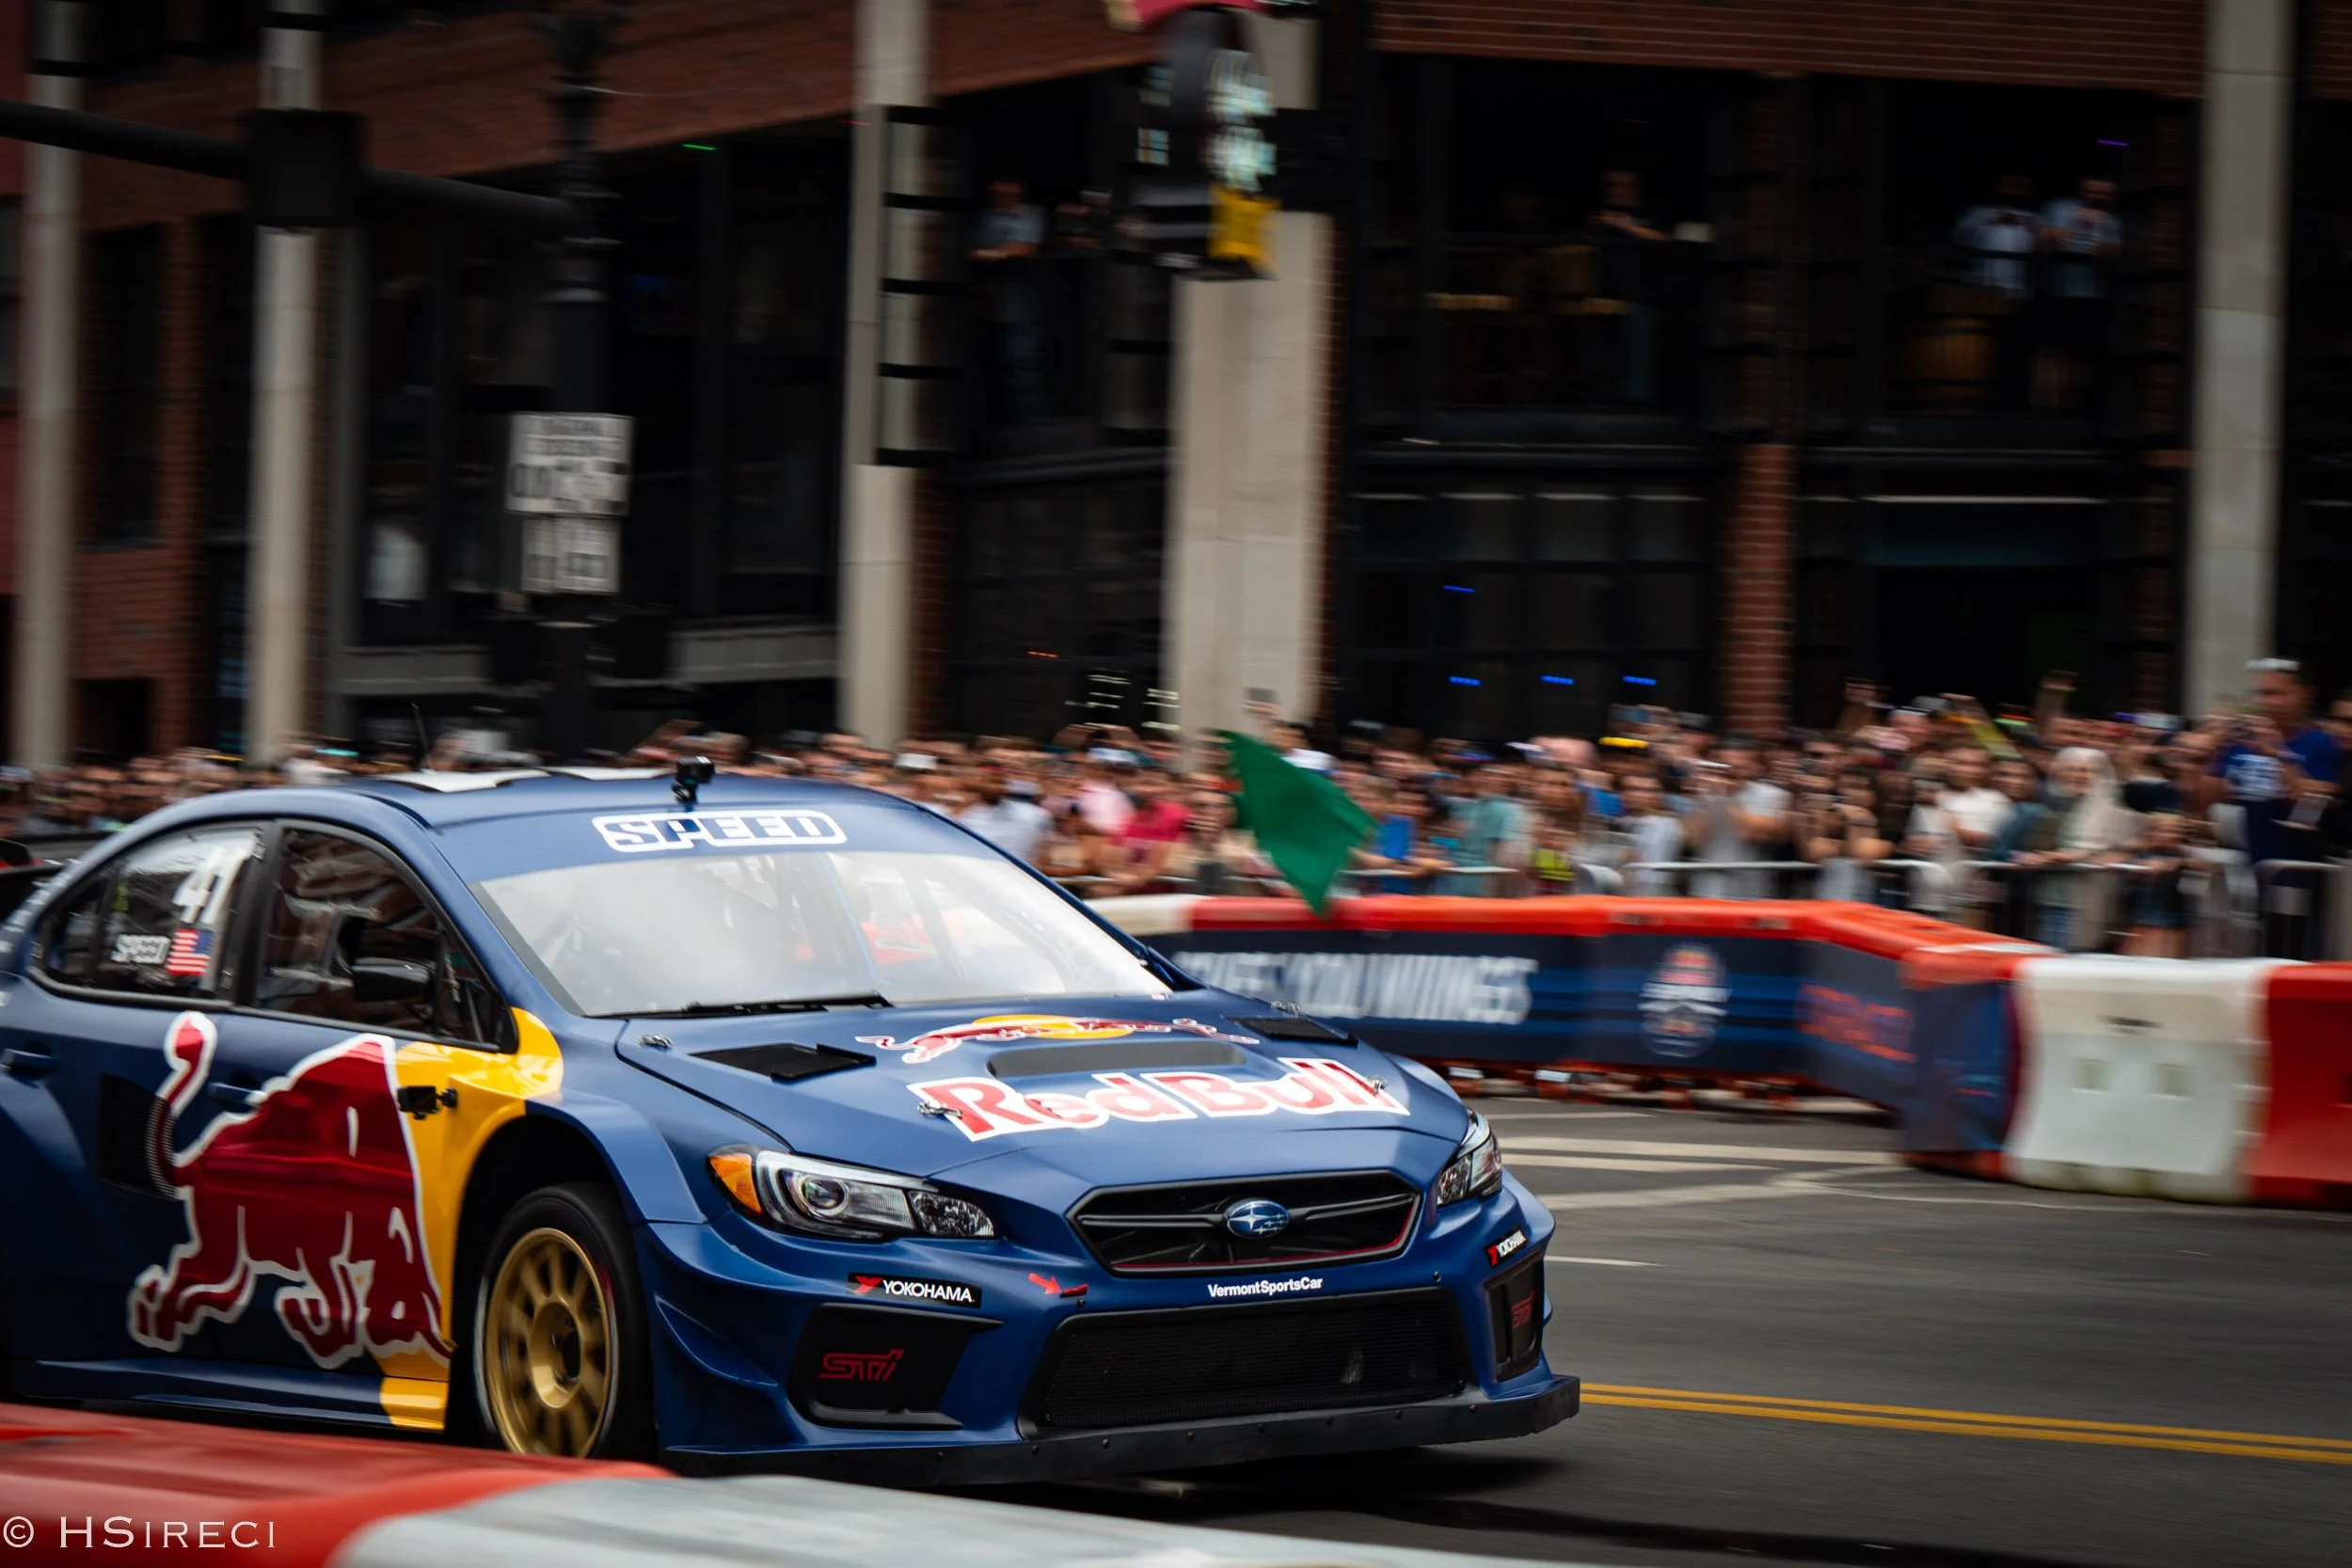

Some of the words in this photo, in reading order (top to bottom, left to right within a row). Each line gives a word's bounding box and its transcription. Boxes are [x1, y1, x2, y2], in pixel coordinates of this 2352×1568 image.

[596, 811, 844, 850] SPEED
[909, 1073, 1197, 1140] Red
[1141, 1058, 1409, 1117] Bull
[882, 1279, 975, 1304] YOKOHAMA
